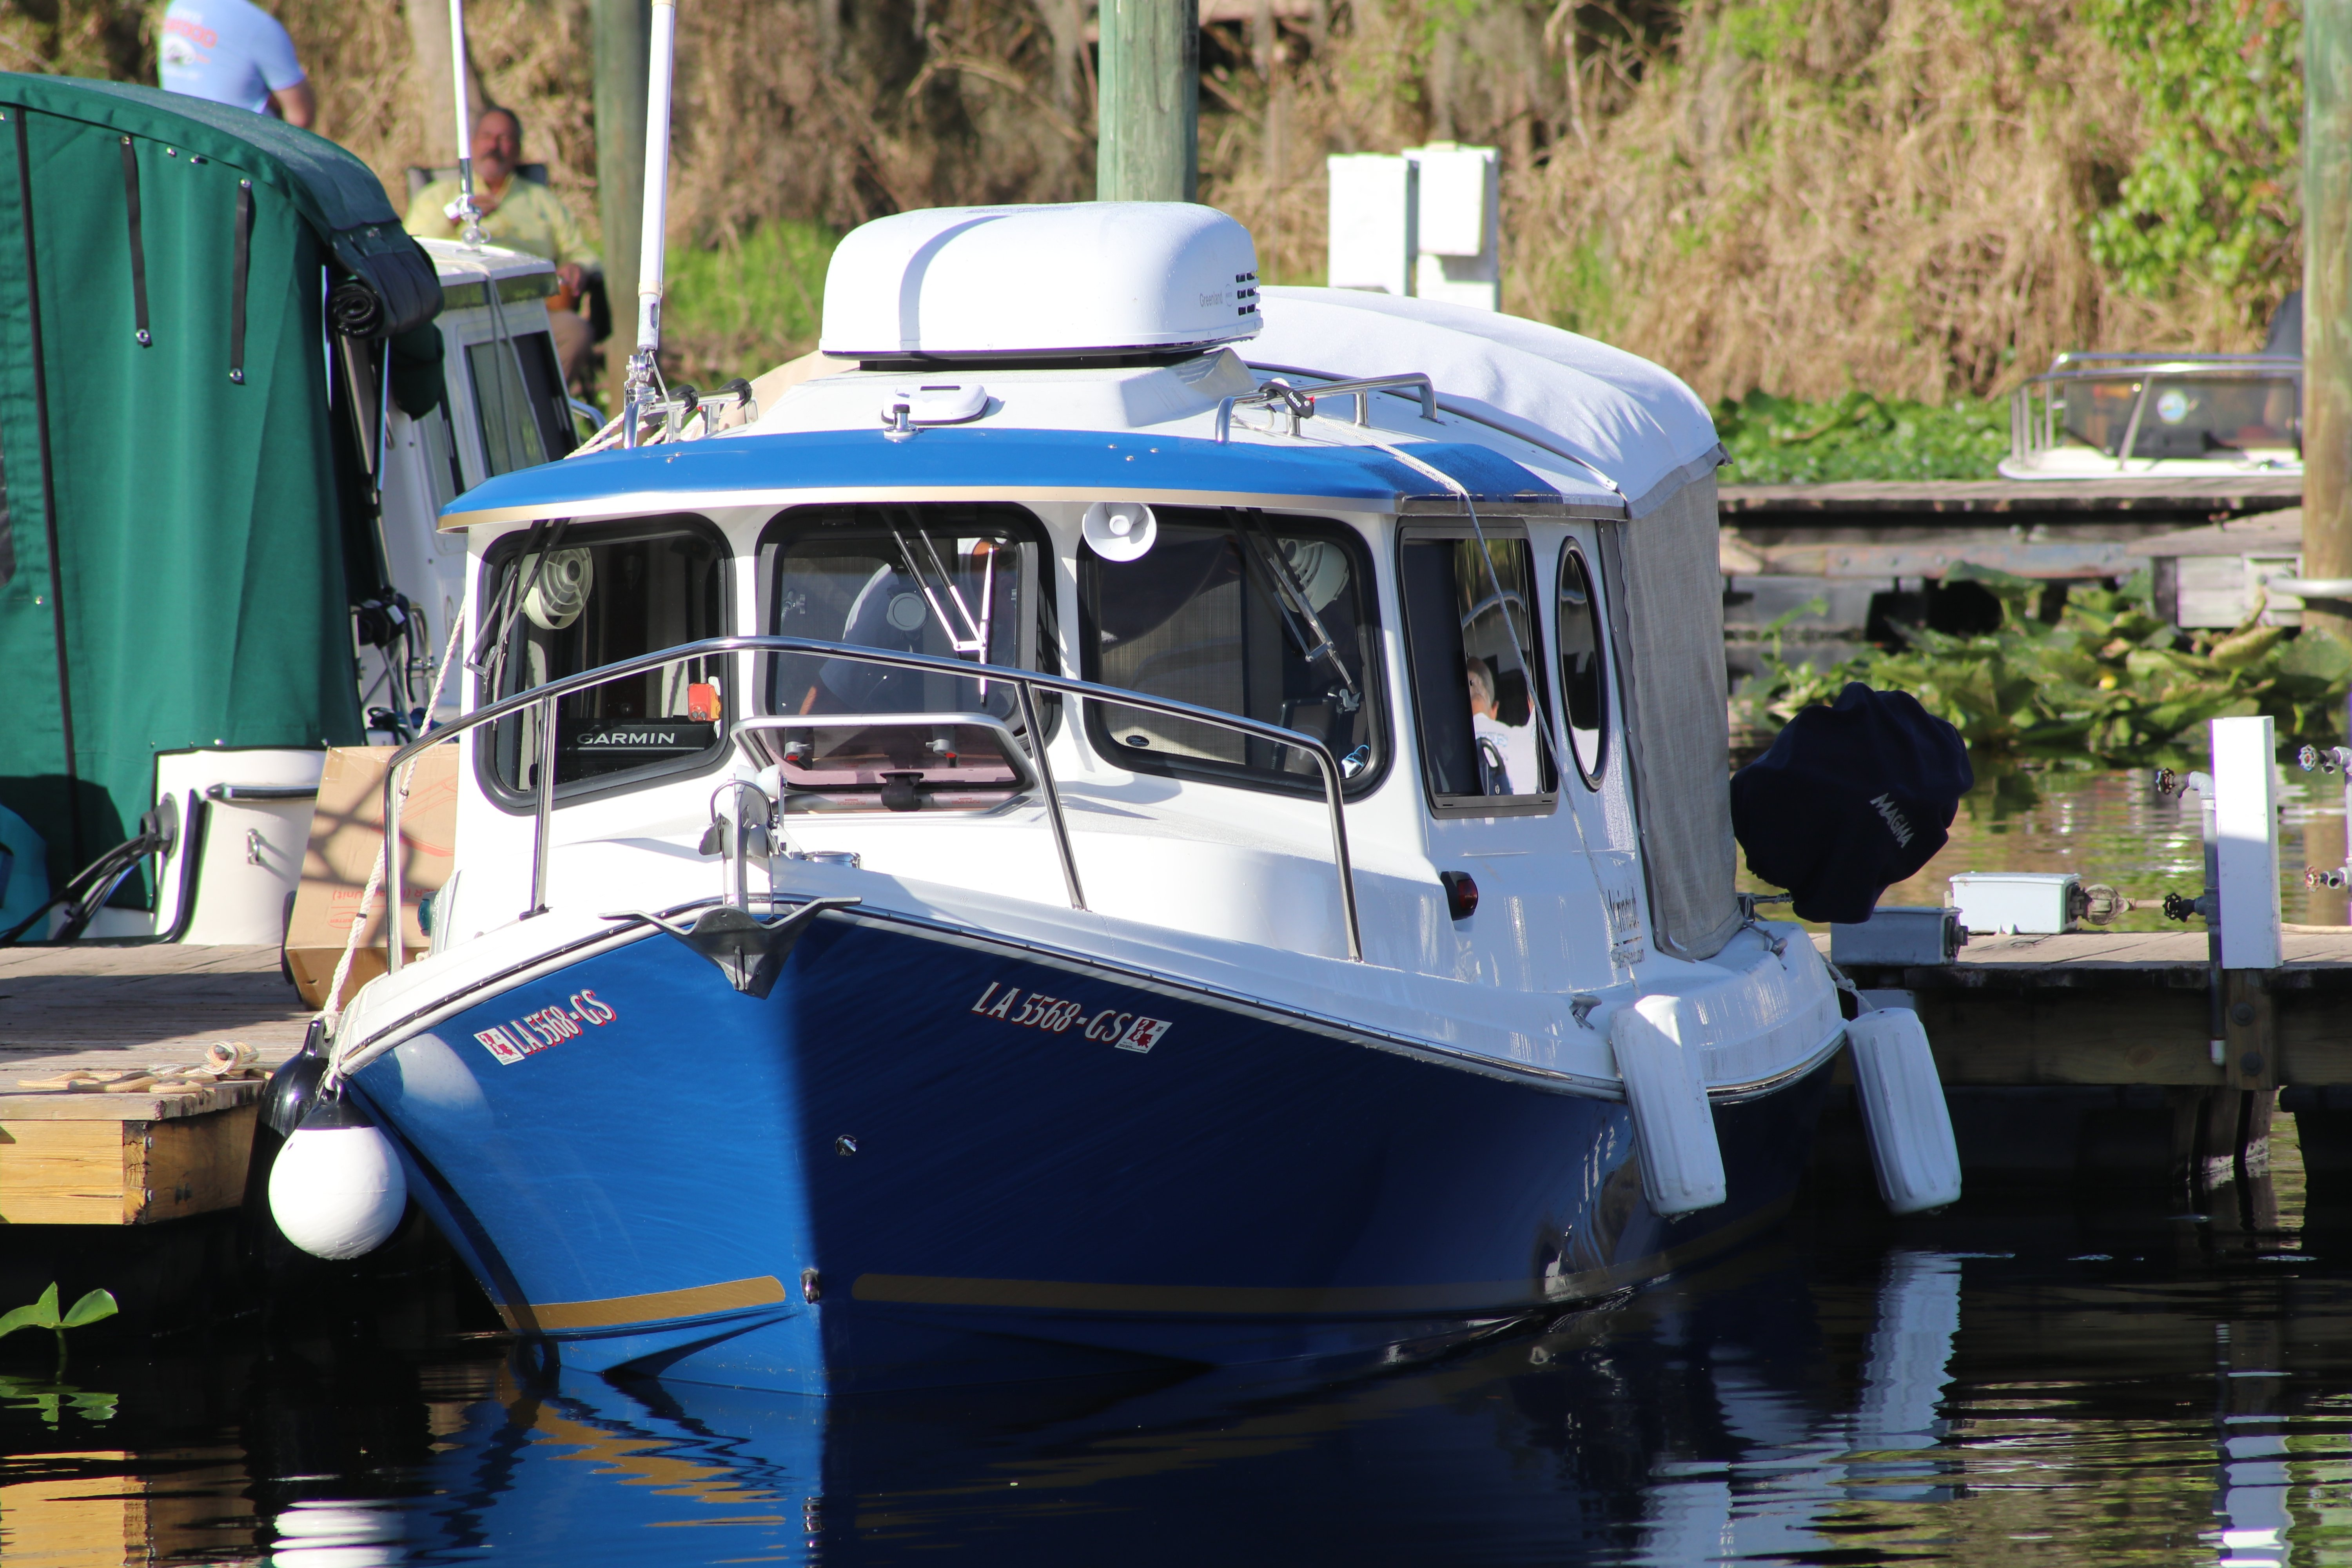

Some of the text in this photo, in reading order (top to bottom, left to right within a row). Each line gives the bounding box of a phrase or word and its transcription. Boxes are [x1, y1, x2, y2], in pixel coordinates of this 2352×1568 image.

[1199, 290, 1223, 307] Greenland
[577, 732, 675, 744] GARMIN
[1869, 793, 1915, 849] MAGMA
[333, 890, 363, 900] Unit)
[497, 989, 617, 1055] LA 5568-GS
[971, 981, 1133, 1042] LA 5568-GS
